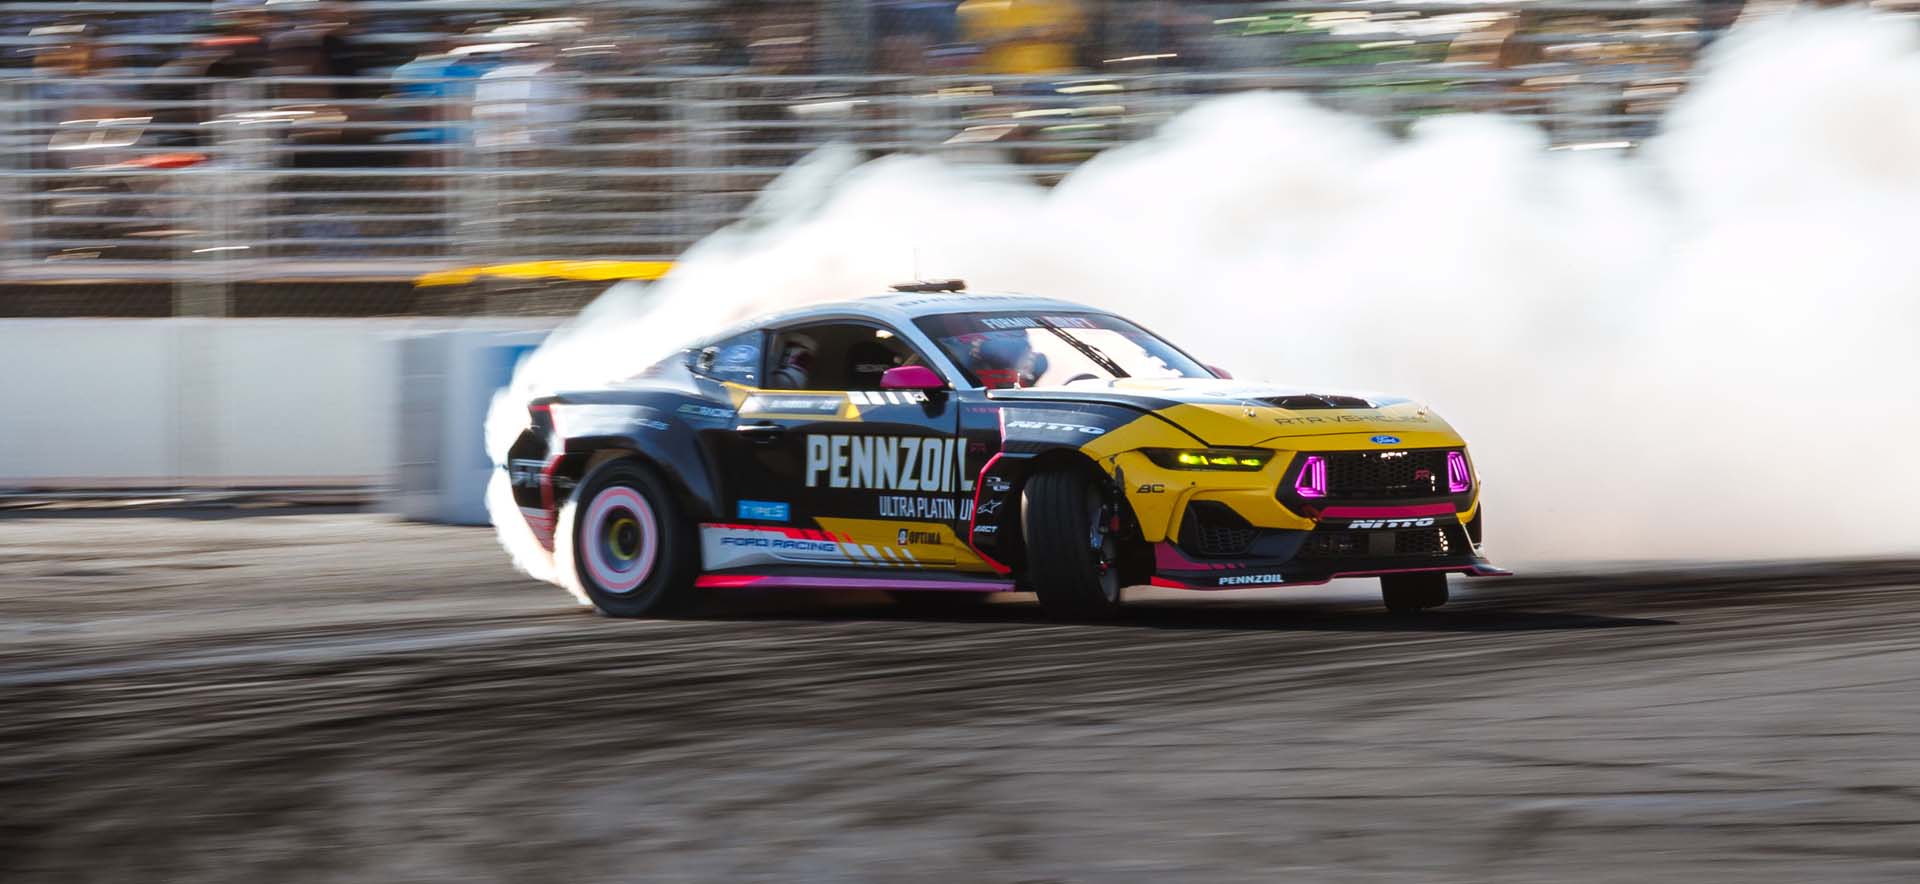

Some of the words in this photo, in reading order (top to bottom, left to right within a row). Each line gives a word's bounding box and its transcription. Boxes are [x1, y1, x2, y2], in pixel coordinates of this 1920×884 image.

[981, 316, 1040, 329] FORMUL
[1006, 420, 1106, 434] NITTO
[805, 434, 975, 493] PENNZOIL
[1136, 484, 1165, 494] BC
[879, 496, 916, 517] ULTRA
[1349, 517, 1435, 529] NITTO
[721, 537, 769, 547] FORD
[772, 540, 836, 552] RACING
[910, 531, 942, 545] OPTIMA
[1219, 574, 1284, 585] PENNZOIL
